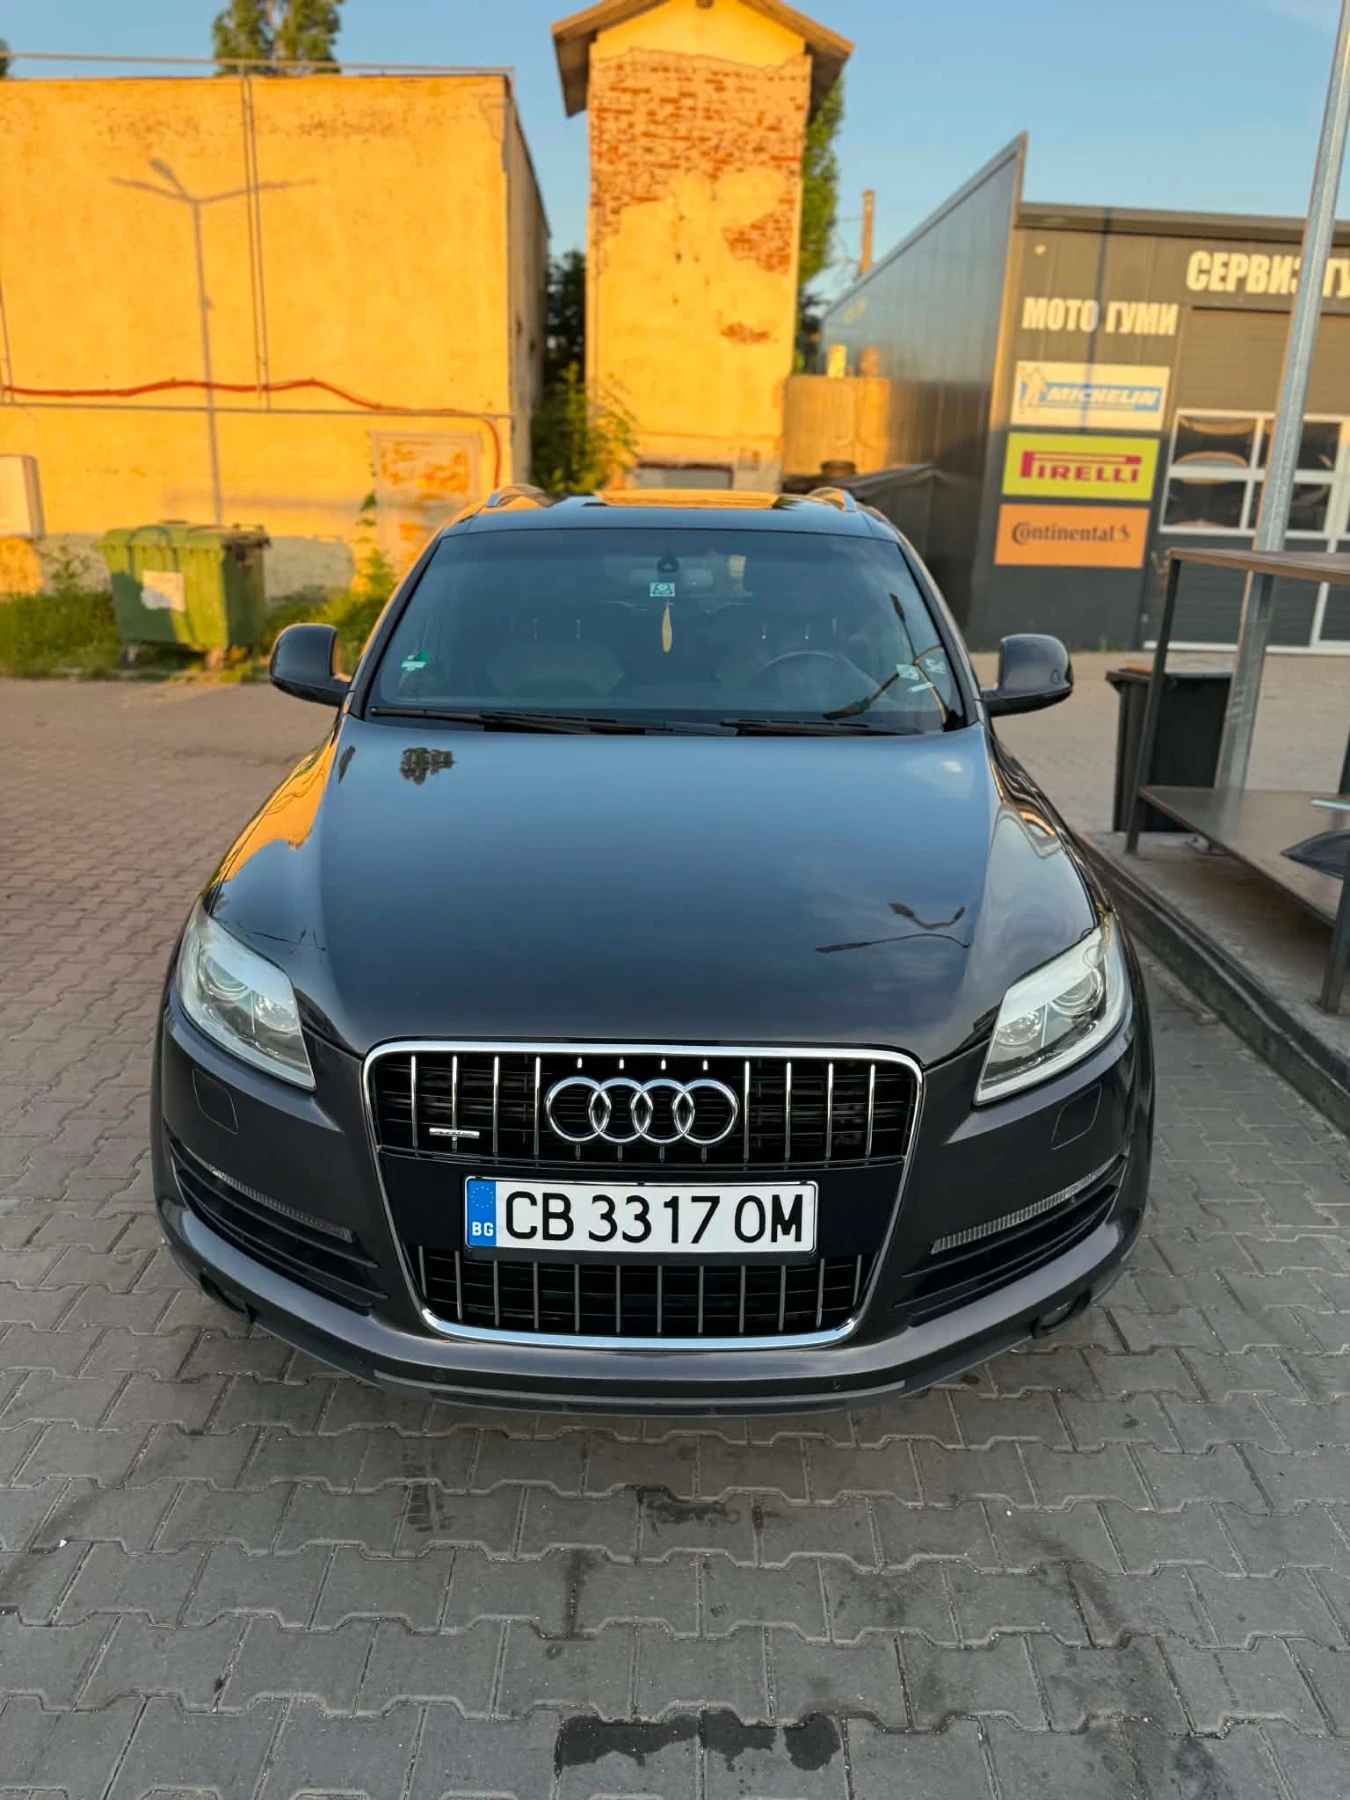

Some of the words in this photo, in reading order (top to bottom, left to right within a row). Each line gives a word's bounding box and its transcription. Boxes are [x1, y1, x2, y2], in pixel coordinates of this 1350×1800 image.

[1021, 297, 1099, 333] МОТО
[1105, 301, 1179, 335] ГУМИ
[1047, 386, 1159, 406] MICHELIN
[1020, 450, 1143, 484] PIRELLI
[1012, 521, 1116, 545] Continental
[471, 1221, 494, 1237] BG
[505, 1190, 575, 1241] CB
[588, 1194, 721, 1244] 3317
[733, 1194, 804, 1243] OM
